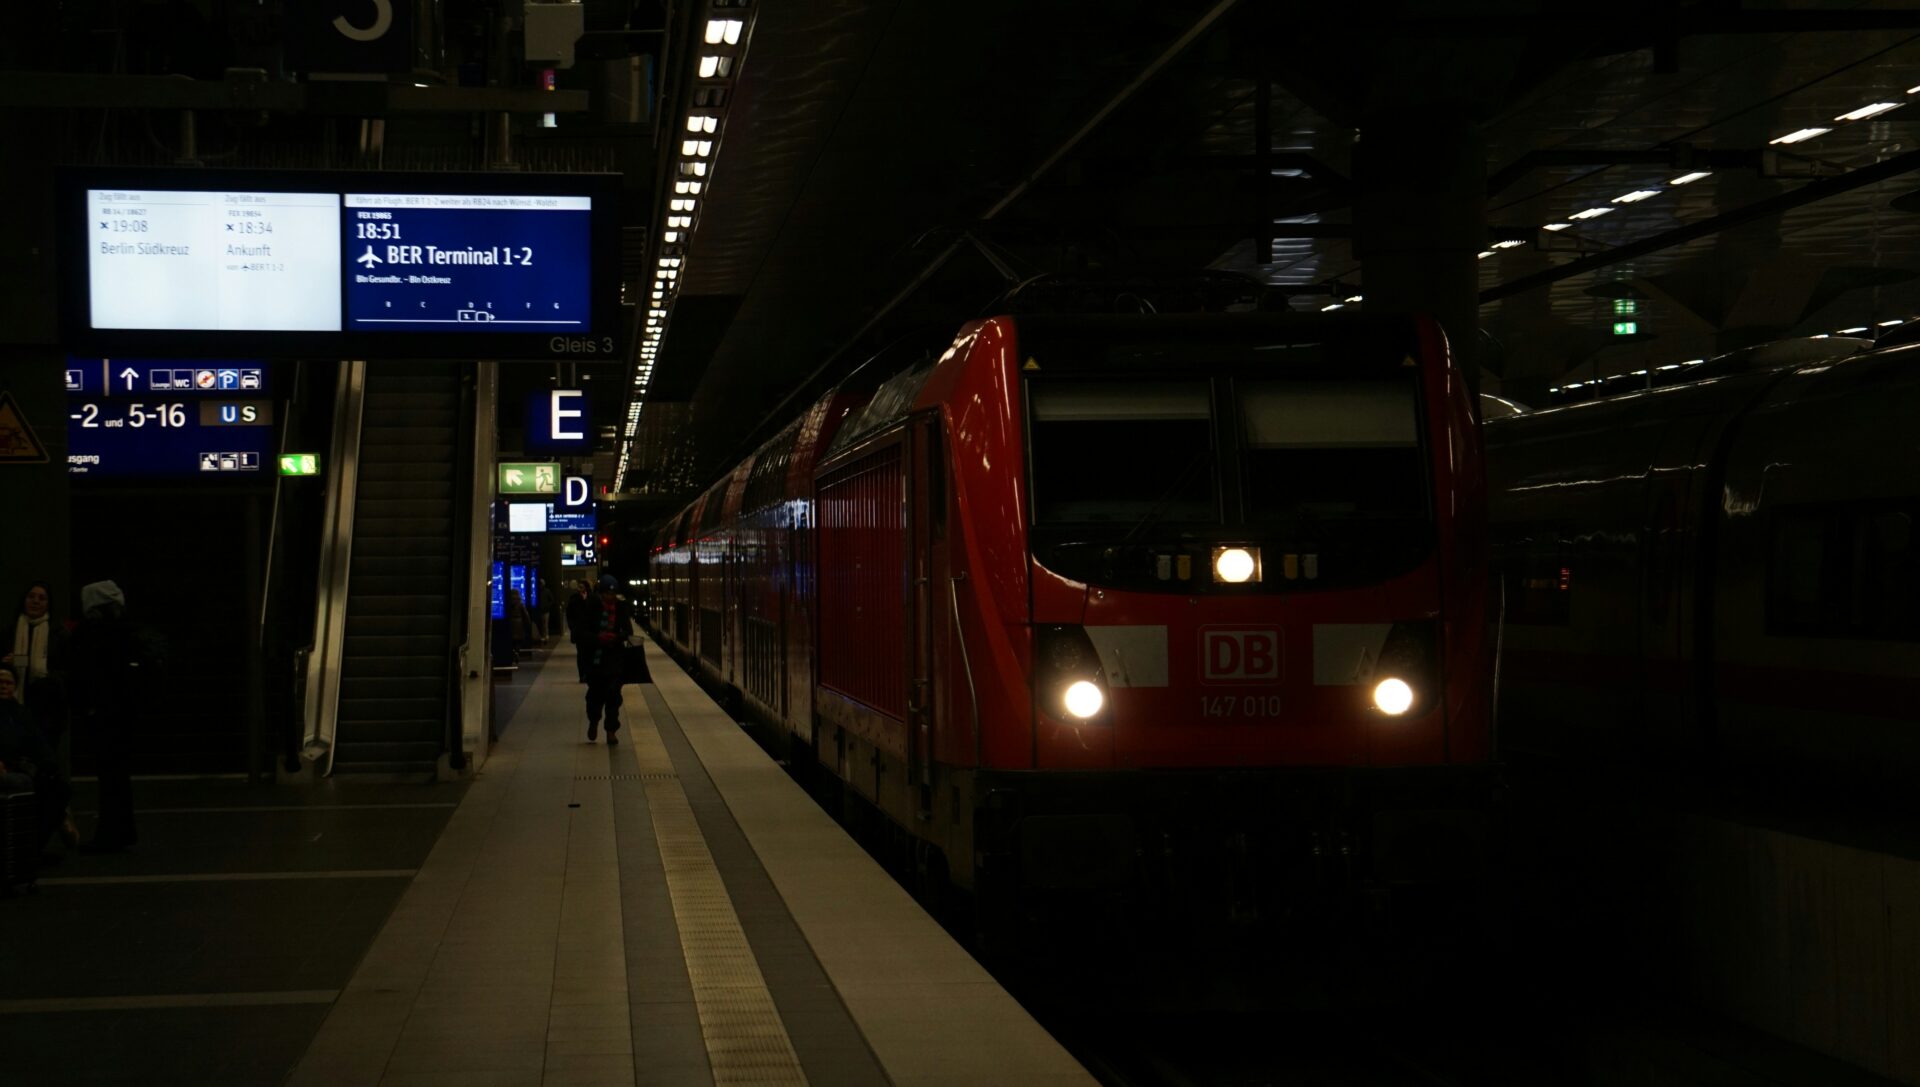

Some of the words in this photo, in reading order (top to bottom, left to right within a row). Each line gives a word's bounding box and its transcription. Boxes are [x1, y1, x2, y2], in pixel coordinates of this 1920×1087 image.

[113, 220, 149, 232] 19:08
[239, 221, 273, 234] 18:34
[356, 222, 401, 240] 18:51
[101, 242, 135, 255] Berlin
[138, 242, 190, 256] Südkreuz
[226, 244, 272, 257] Ankunft
[387, 245, 423, 265] BER
[426, 246, 499, 266] Terminal
[502, 247, 533, 266] 1-2
[550, 336, 596, 354] Gleis
[602, 336, 614, 354] 3
[174, 379, 190, 388] WC
[104, 417, 124, 428] und
[128, 402, 187, 428] 5-16
[222, 405, 237, 422] U
[241, 406, 257, 422] S
[551, 390, 584, 439] E
[566, 476, 588, 506] D
[1210, 635, 1273, 675] DB
[1200, 695, 1236, 718] 147
[1243, 695, 1281, 718] 010
